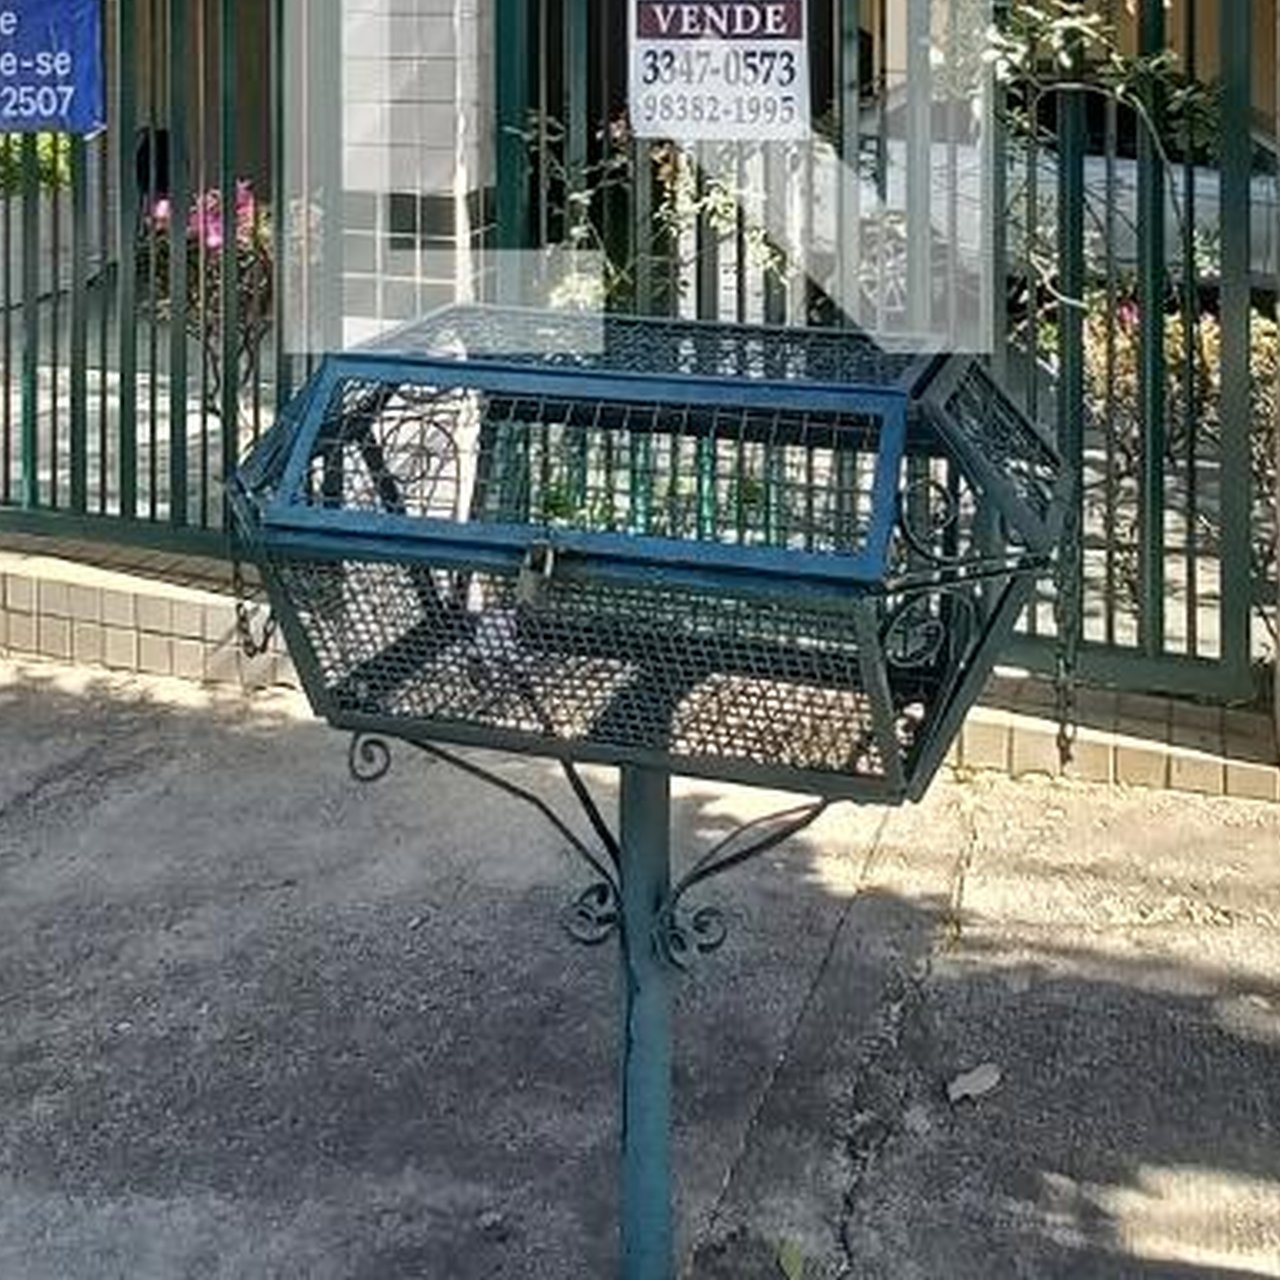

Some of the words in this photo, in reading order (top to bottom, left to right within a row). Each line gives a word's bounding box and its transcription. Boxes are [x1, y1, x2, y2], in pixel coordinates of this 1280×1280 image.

[651, 5, 788, 34] VENDE
[642, 49, 797, 87] 3347-0573
[643, 94, 795, 124] 98382-1995
